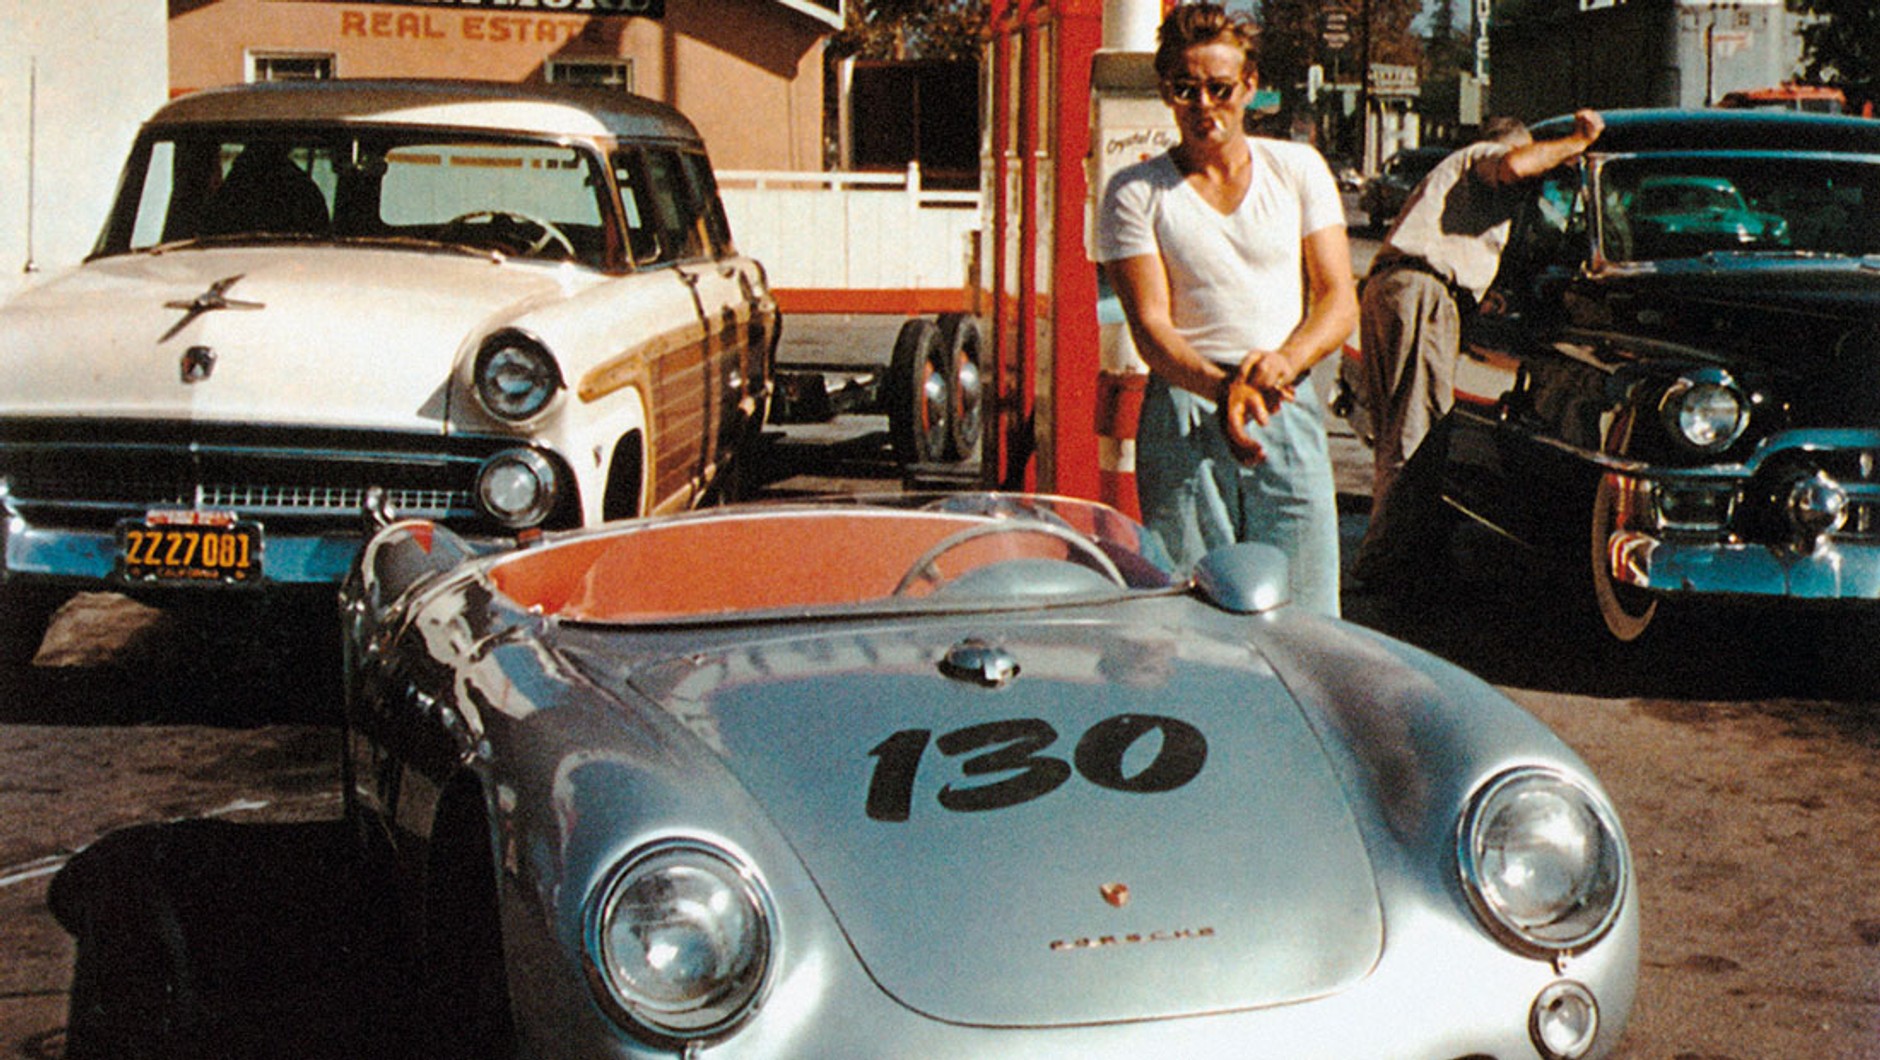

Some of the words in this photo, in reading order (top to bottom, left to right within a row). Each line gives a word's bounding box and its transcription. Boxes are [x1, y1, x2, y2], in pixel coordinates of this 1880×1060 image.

[341, 11, 445, 38] REAL
[462, 15, 603, 44] ESTATE
[865, 713, 1209, 823] 130
[1049, 927, 1215, 950] PORSCHE
